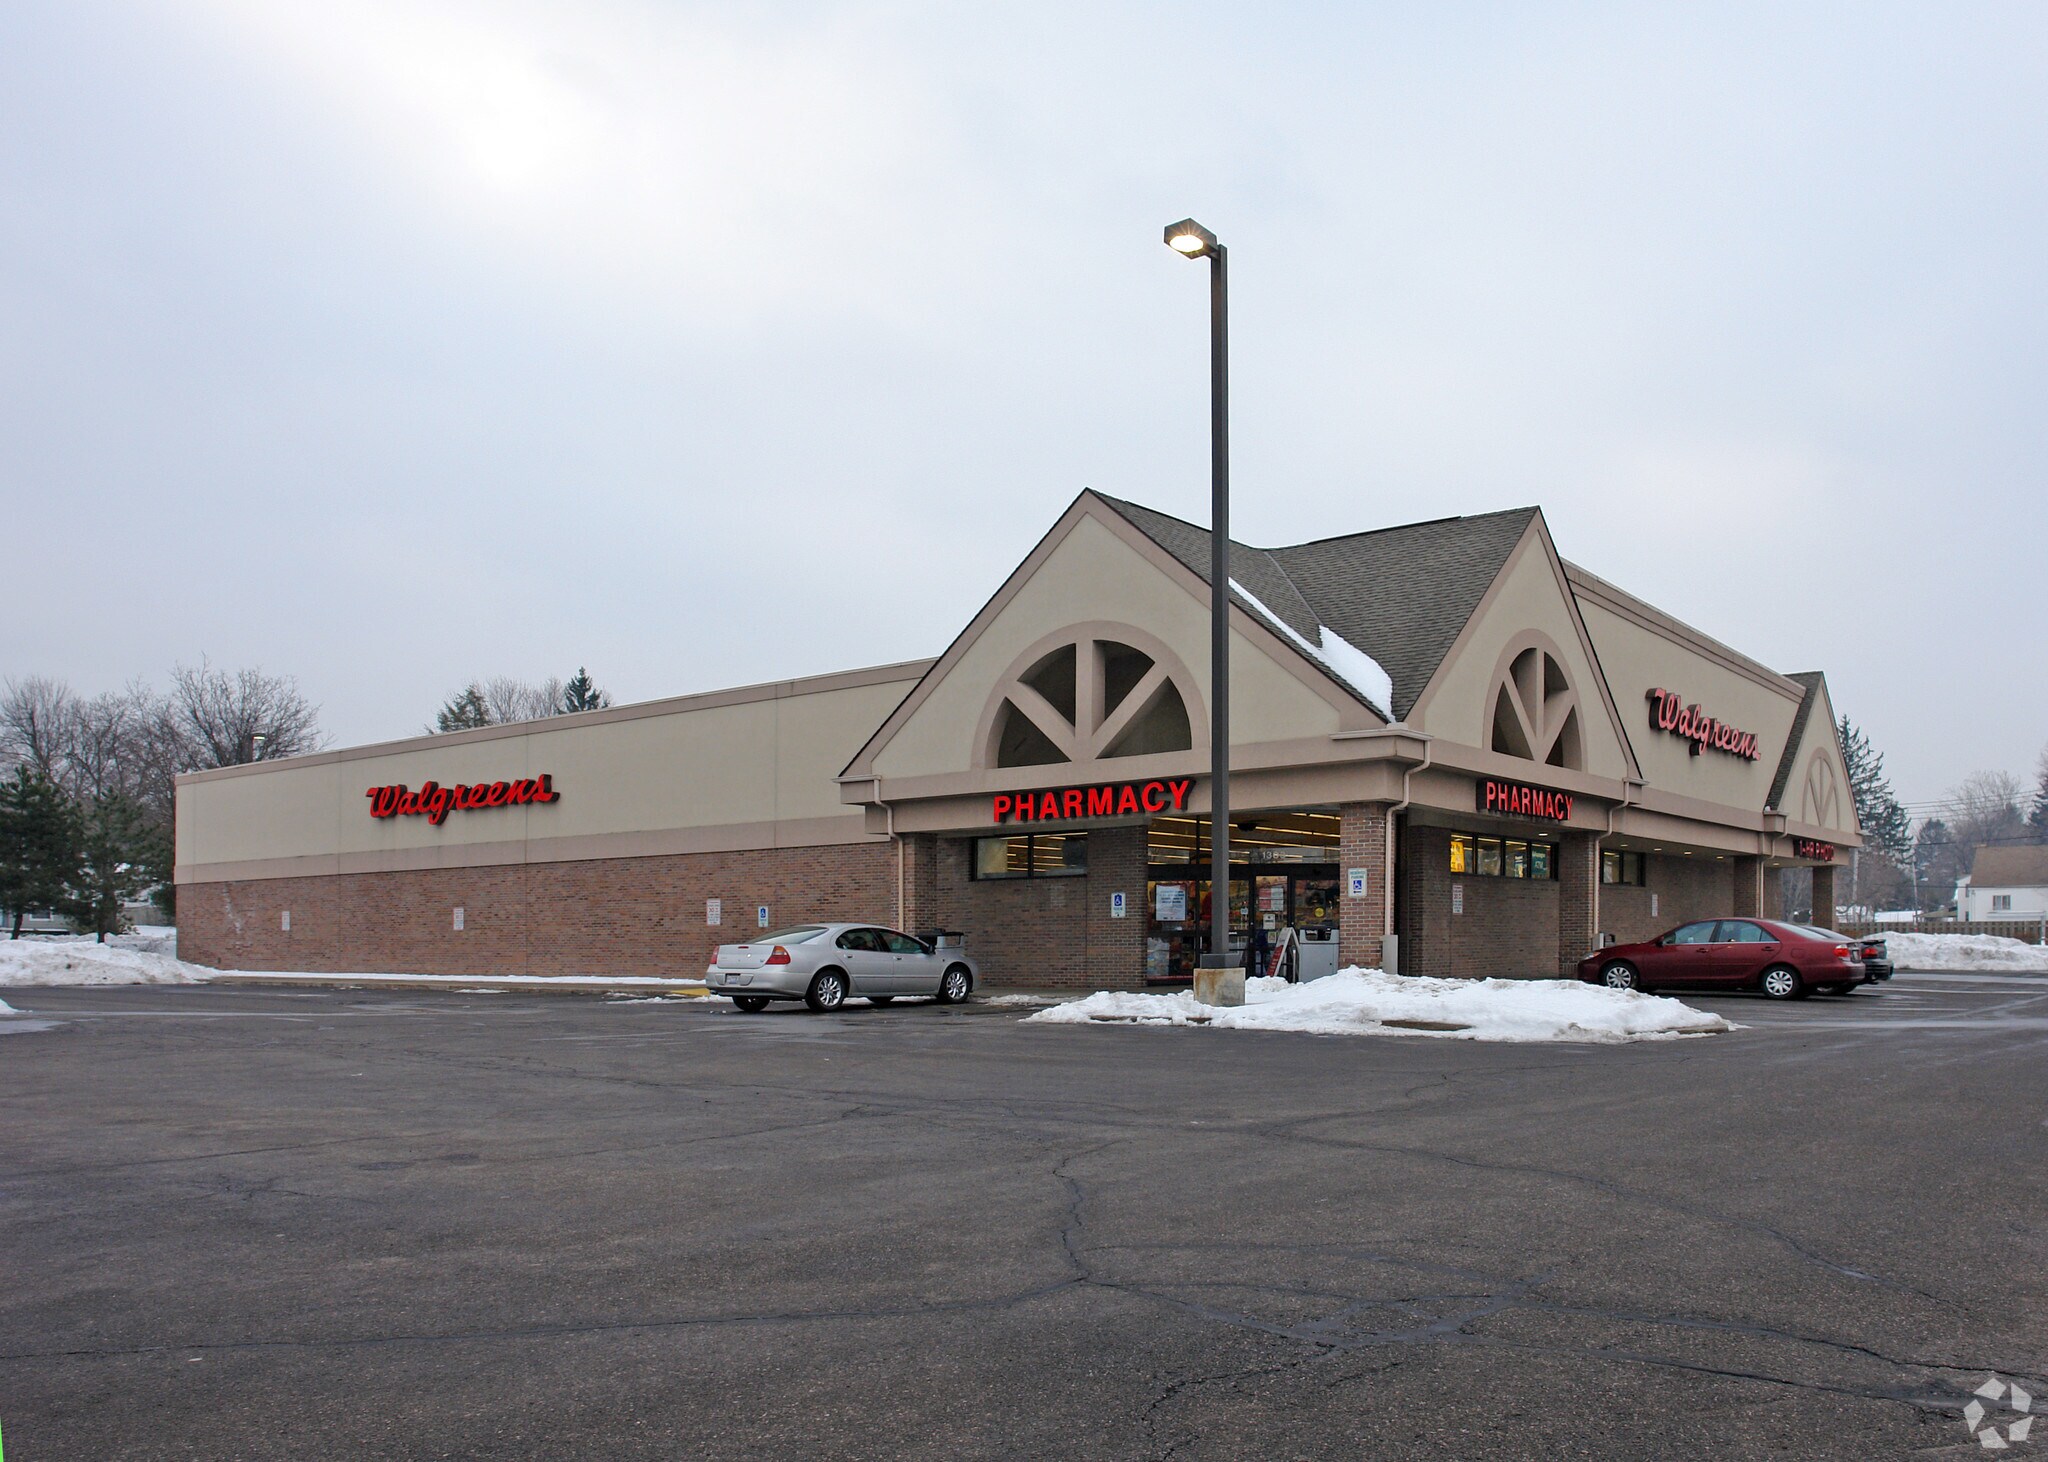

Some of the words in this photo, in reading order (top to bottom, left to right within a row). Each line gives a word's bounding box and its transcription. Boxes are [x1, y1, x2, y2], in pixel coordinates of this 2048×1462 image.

[1646, 687, 1761, 760] Walgreens
[366, 774, 559, 825] Walgreens
[993, 779, 1192, 823] PHARMACY
[1486, 781, 1573, 820] PHARMACY
